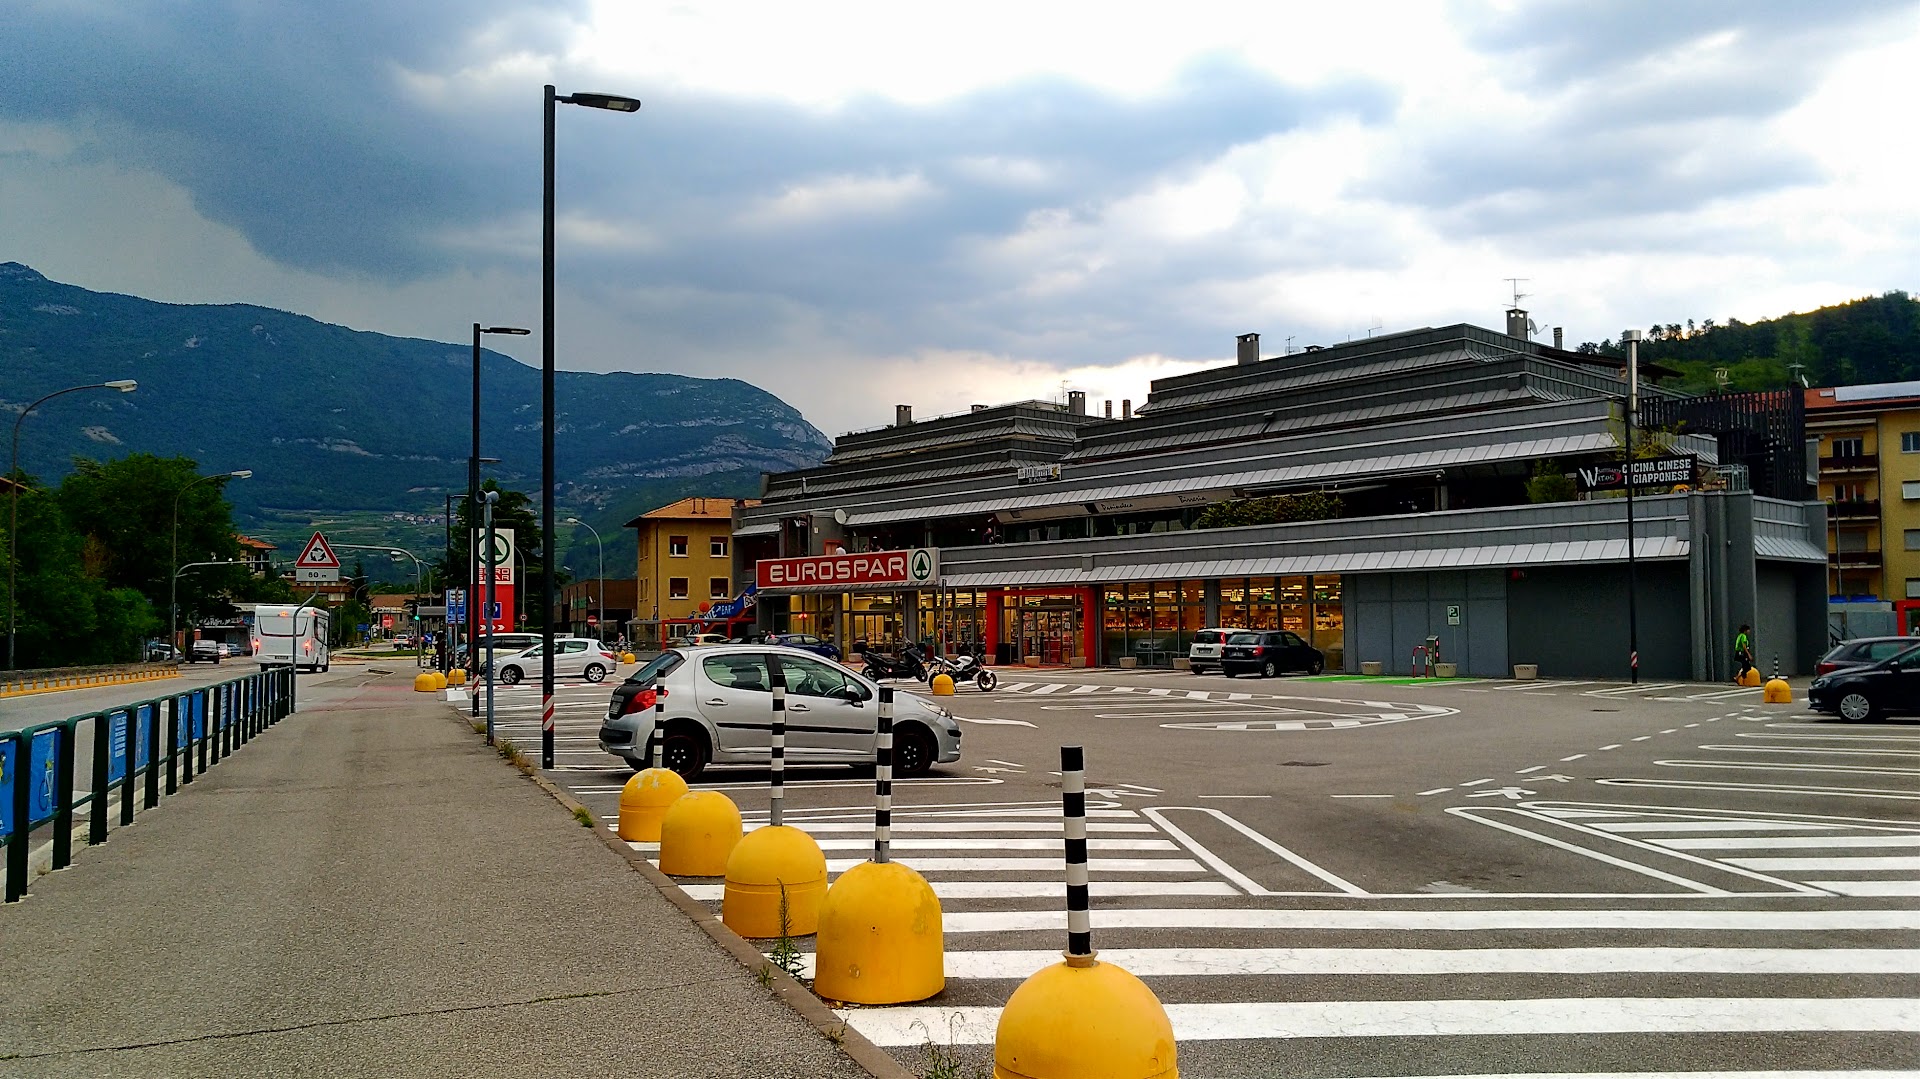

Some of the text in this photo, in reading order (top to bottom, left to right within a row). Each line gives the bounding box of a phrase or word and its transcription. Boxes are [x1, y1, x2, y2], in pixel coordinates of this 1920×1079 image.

[1657, 459, 1691, 472] CINESE
[1632, 471, 1690, 484] GIAPPONESE
[770, 556, 904, 583] EUROSPAR
